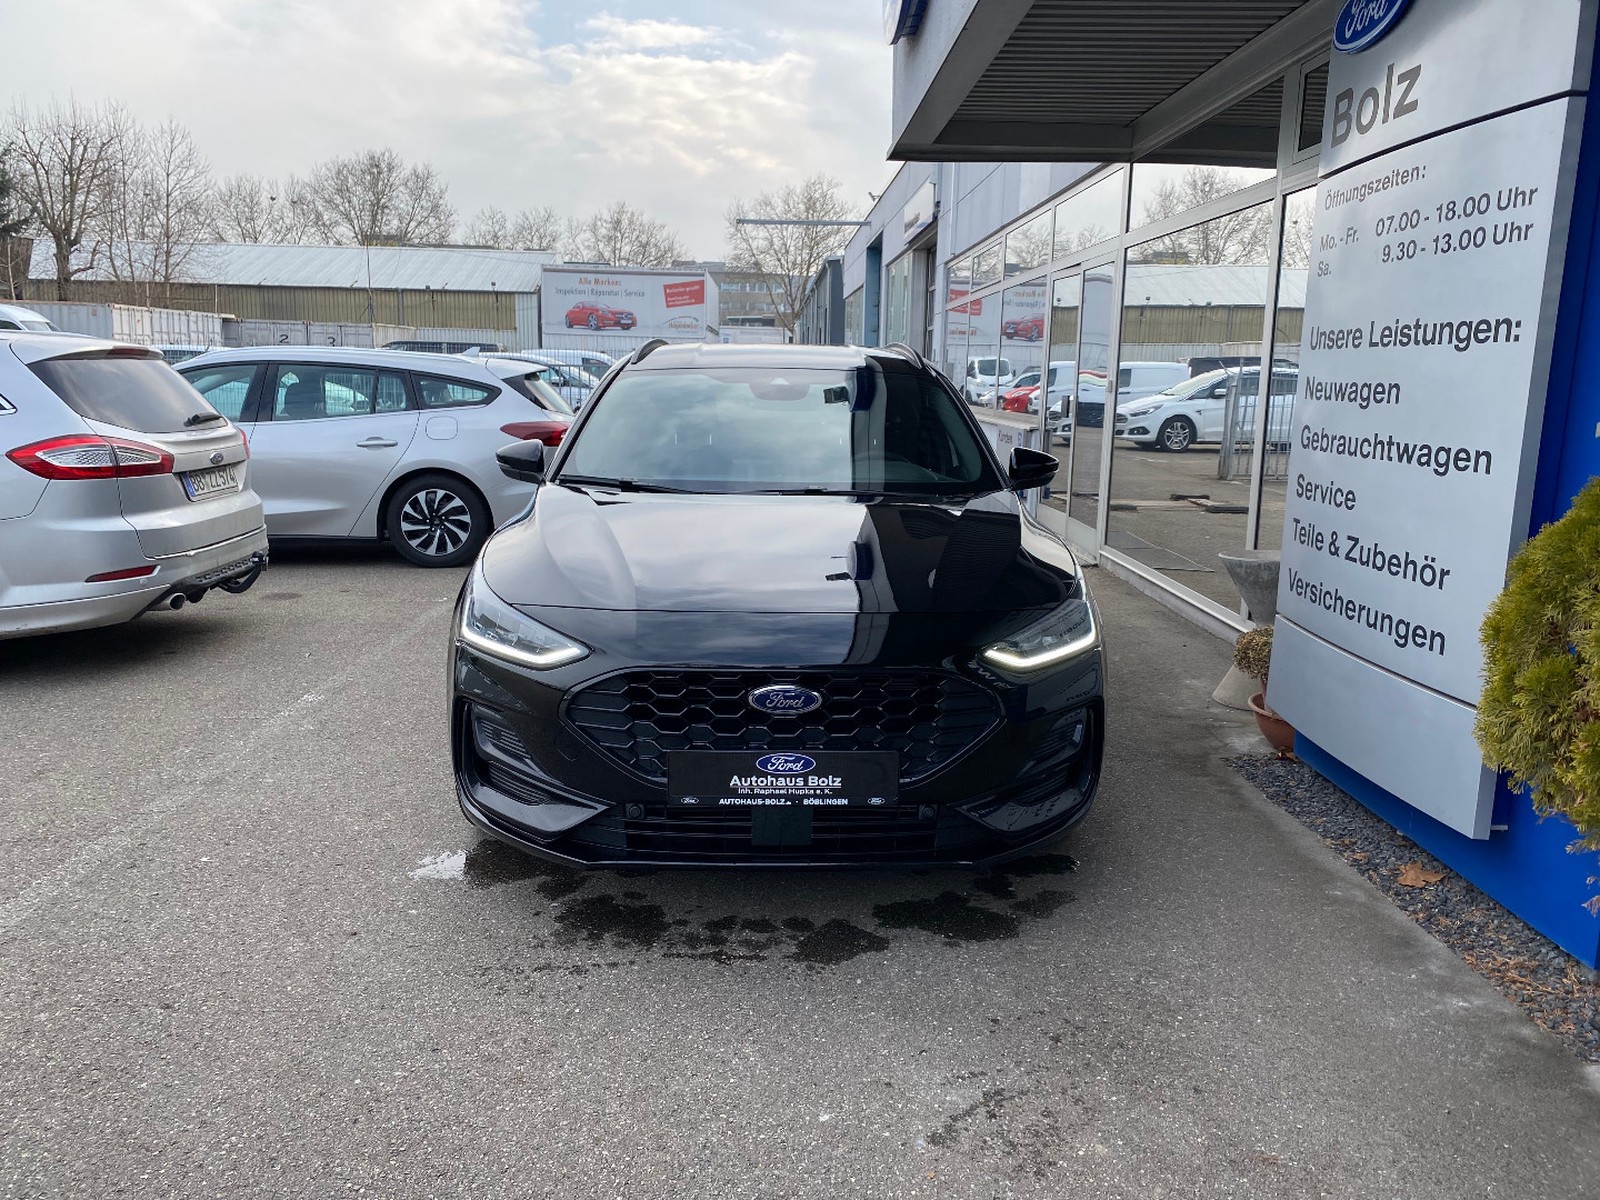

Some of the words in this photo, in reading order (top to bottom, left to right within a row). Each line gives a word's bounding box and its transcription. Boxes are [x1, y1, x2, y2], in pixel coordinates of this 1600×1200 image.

[1330, 62, 1422, 149] Bolz
[1324, 165, 1427, 211] Öffnungszeiten:
[1375, 209, 1421, 237] 07.00
[1436, 192, 1491, 224] 18.00
[1497, 186, 1539, 212] Uhr
[1317, 260, 1332, 278] Sa.
[1381, 239, 1418, 263] 9.30
[1432, 226, 1486, 255] 13.00
[1493, 221, 1534, 246] Uhr
[279, 333, 289, 344] 2
[1309, 325, 1363, 350] Unsere
[1368, 317, 1522, 353] Leistungen:
[1304, 376, 1401, 410] Neuwagen
[1300, 424, 1492, 477] Gebrauchtwagen
[1295, 473, 1357, 511] Service
[1293, 517, 1325, 551] Teile
[1328, 530, 1340, 558] &
[1344, 534, 1451, 590] Zubehör
[1288, 567, 1446, 656] Versicherungen
[766, 691, 805, 708] Ford
[729, 775, 804, 787] Autohaus
[808, 775, 842, 787] Bolz
[767, 755, 805, 771] Ford
[754, 788, 787, 796] Raphael
[803, 797, 849, 806] BÖBLINGEN
